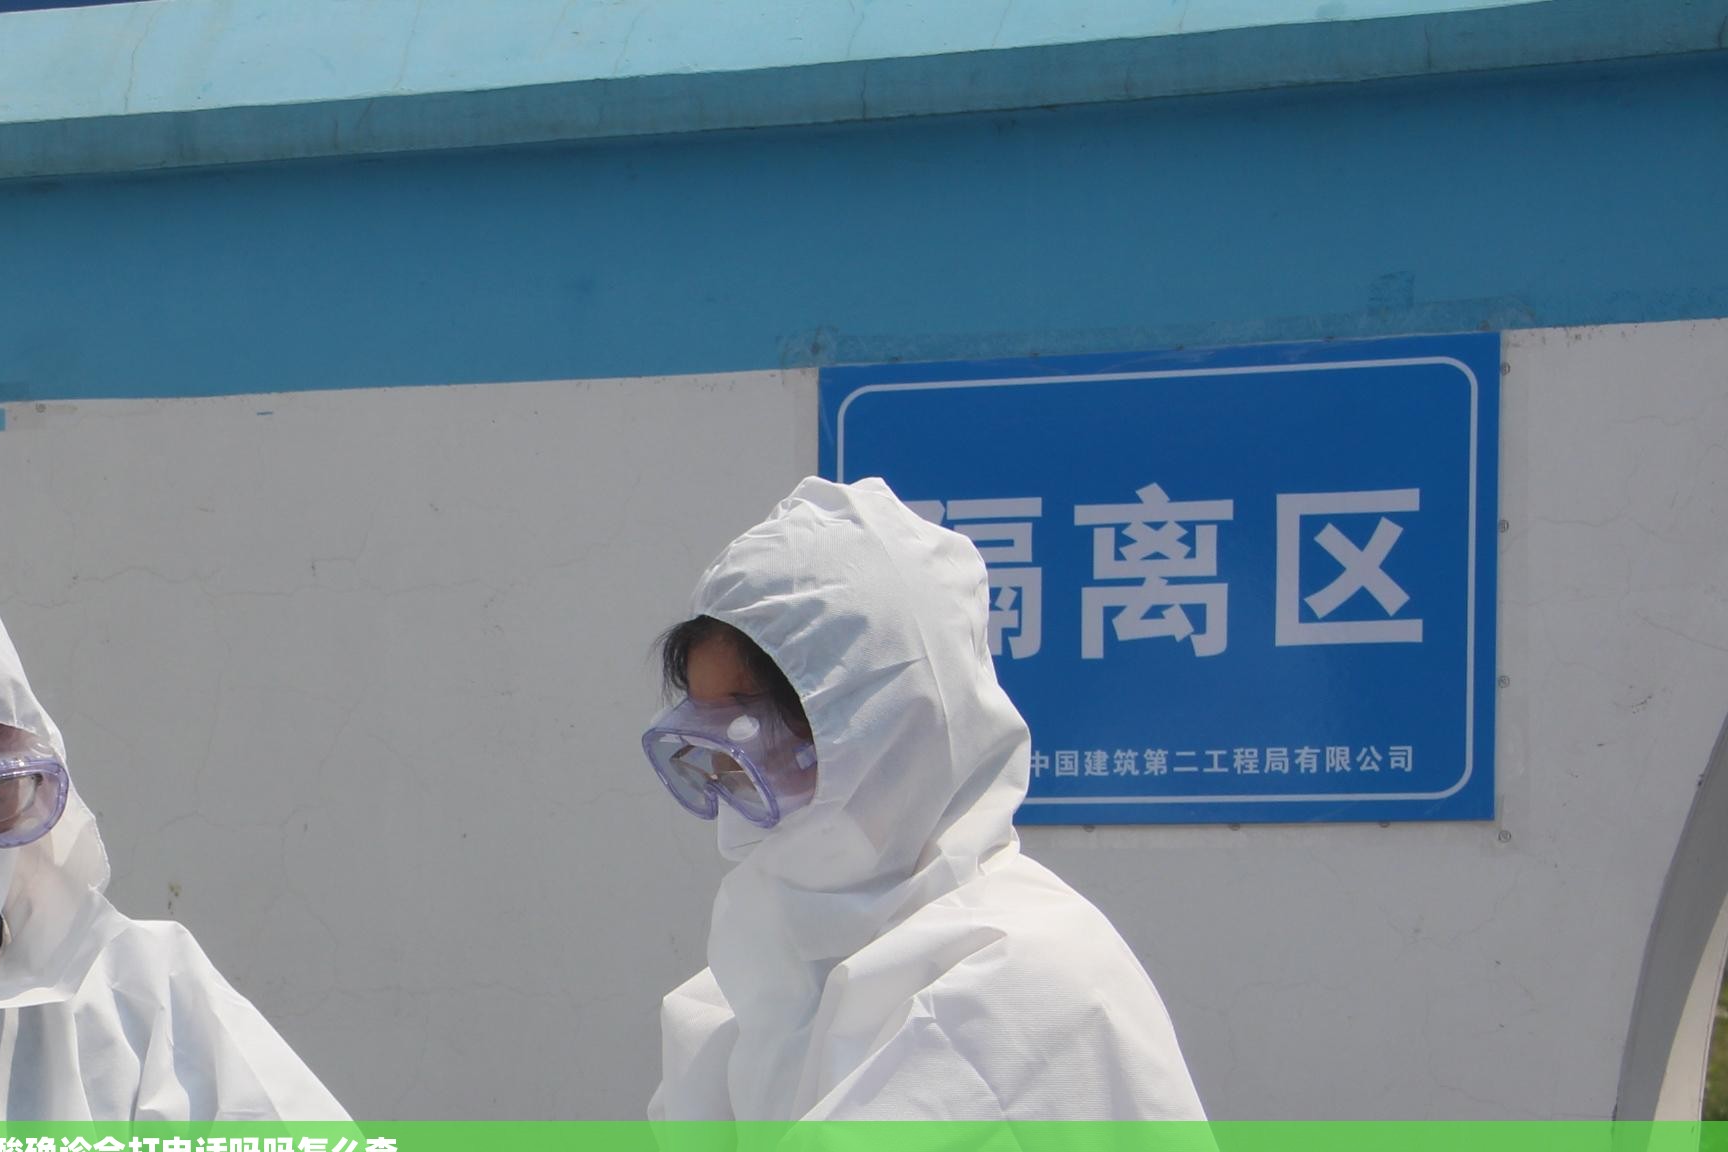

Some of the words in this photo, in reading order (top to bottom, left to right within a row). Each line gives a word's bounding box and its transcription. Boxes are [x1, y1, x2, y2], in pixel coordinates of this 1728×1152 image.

[1030, 745, 1414, 778] 中国建筑第二工程局有限公司
